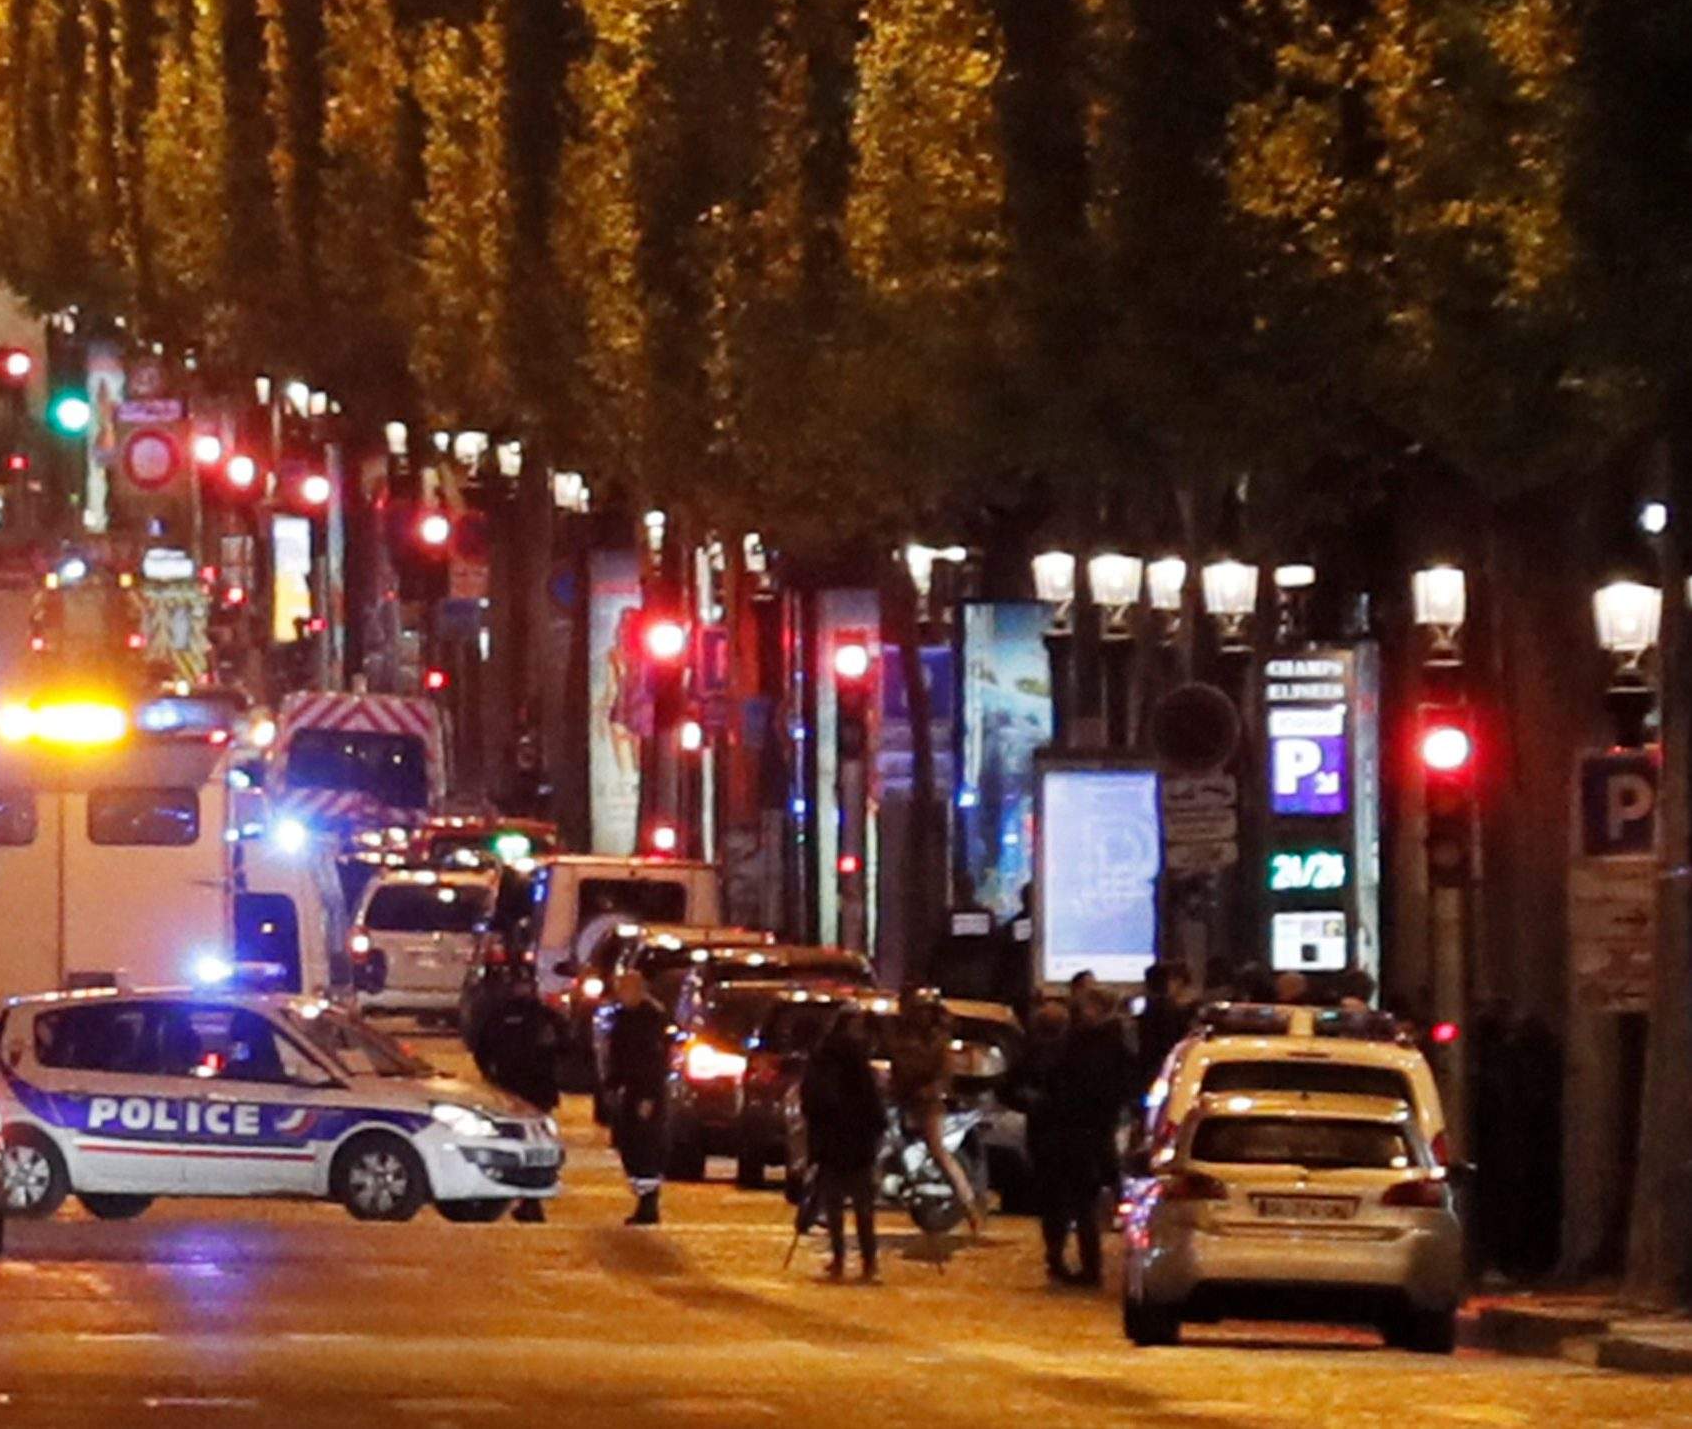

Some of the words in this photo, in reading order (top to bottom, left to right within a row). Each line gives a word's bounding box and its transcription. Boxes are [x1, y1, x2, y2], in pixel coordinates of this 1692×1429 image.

[1265, 659, 1344, 677] CHAMPS
[1274, 738, 1322, 795] P
[1607, 773, 1654, 840] P
[88, 1097, 261, 1136] POLICE
